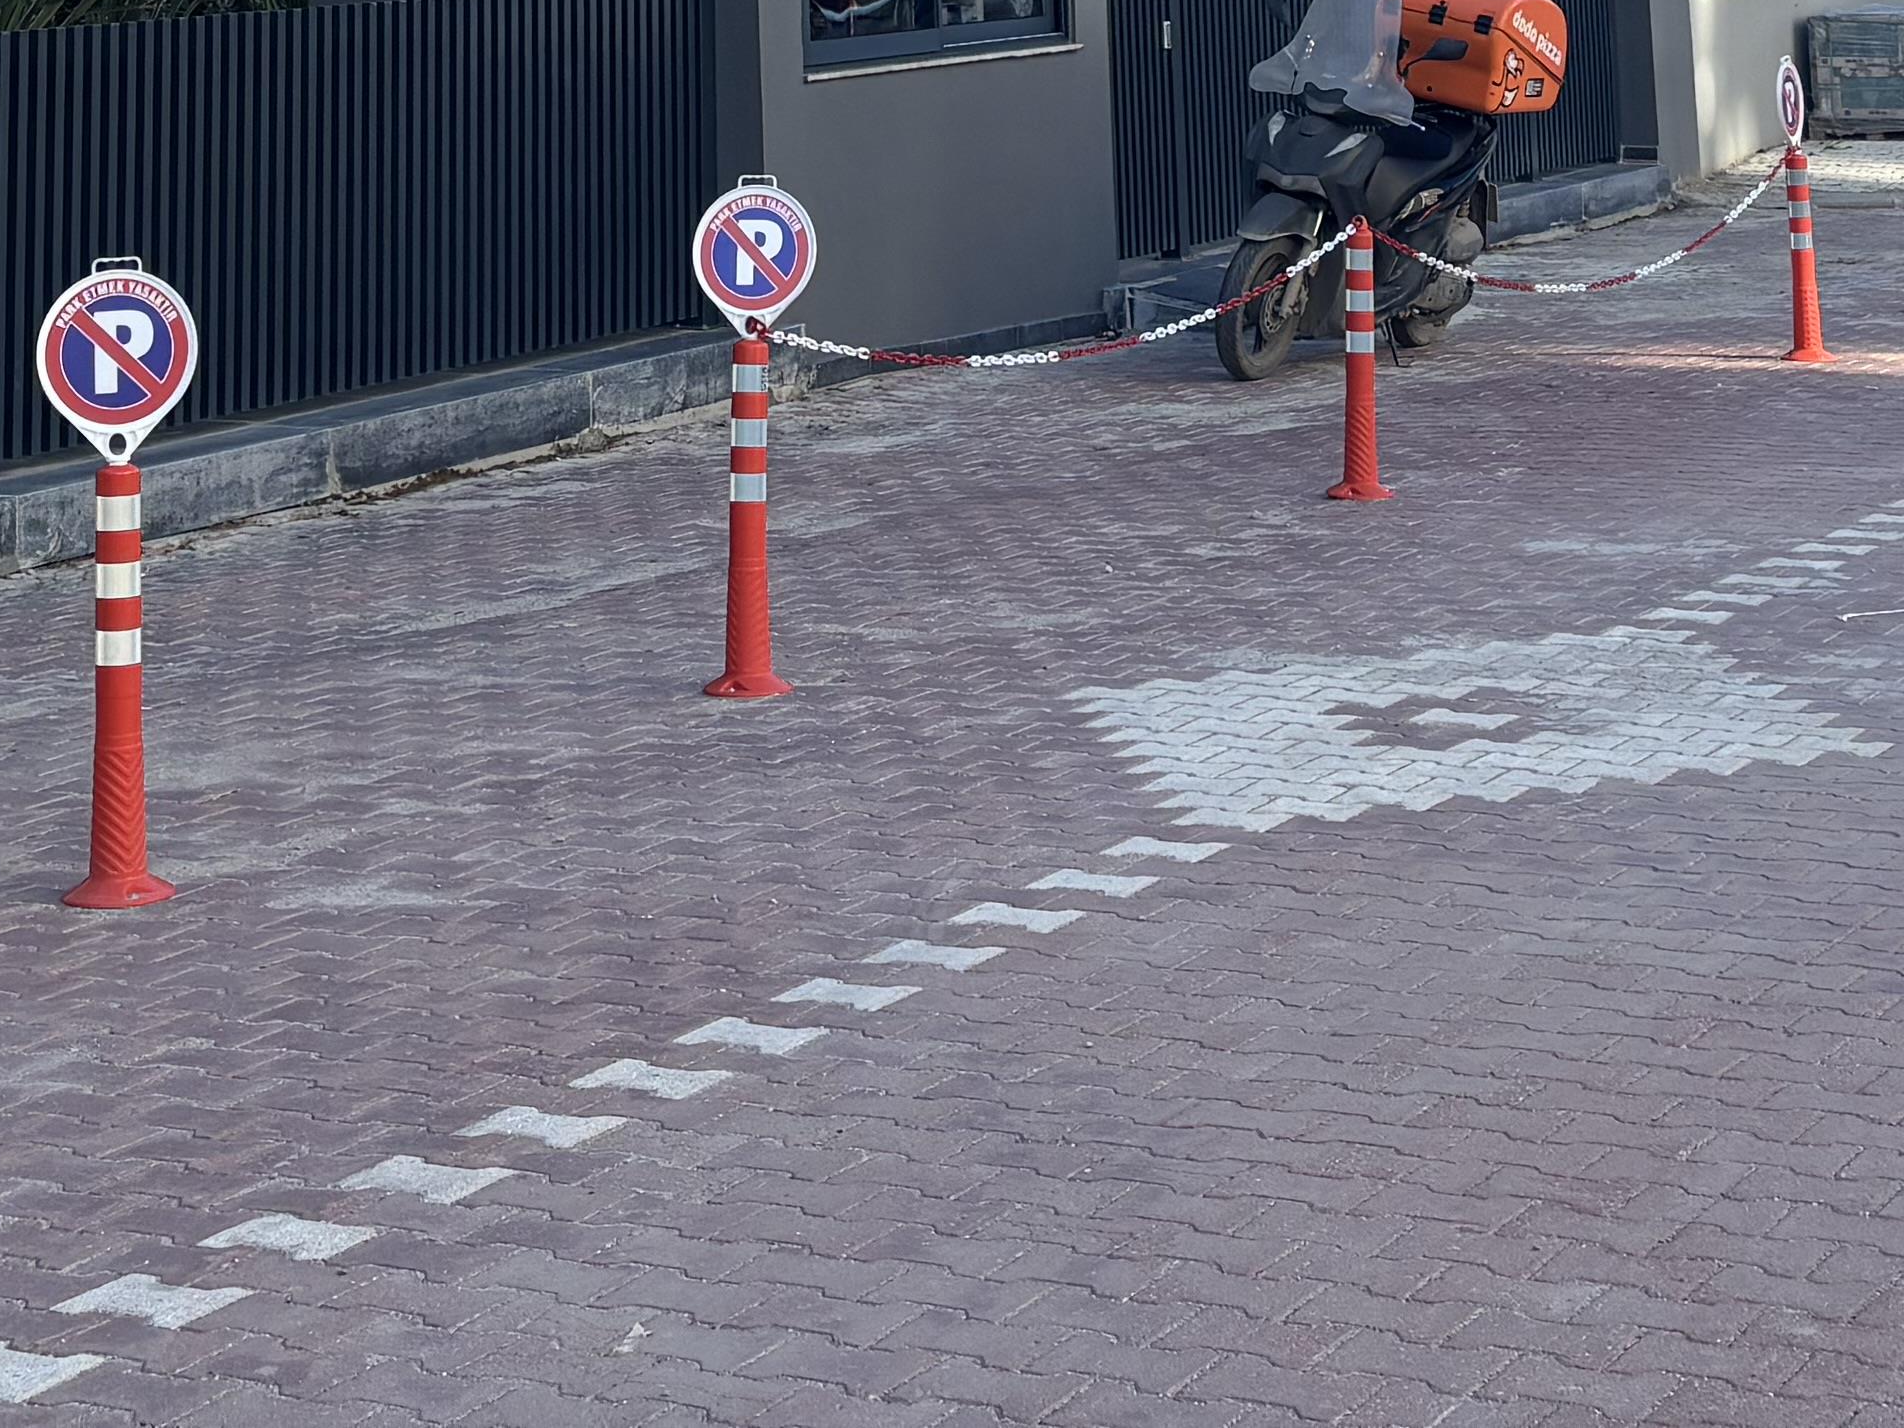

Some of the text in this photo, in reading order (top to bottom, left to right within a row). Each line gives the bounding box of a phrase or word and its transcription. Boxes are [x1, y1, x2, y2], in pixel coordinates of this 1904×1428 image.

[1512, 10, 1562, 66] dodo pizza
[709, 207, 734, 231] PARK
[731, 196, 764, 212] ETMEK
[55, 280, 178, 329] PARK ETMEK YASAKTIR
